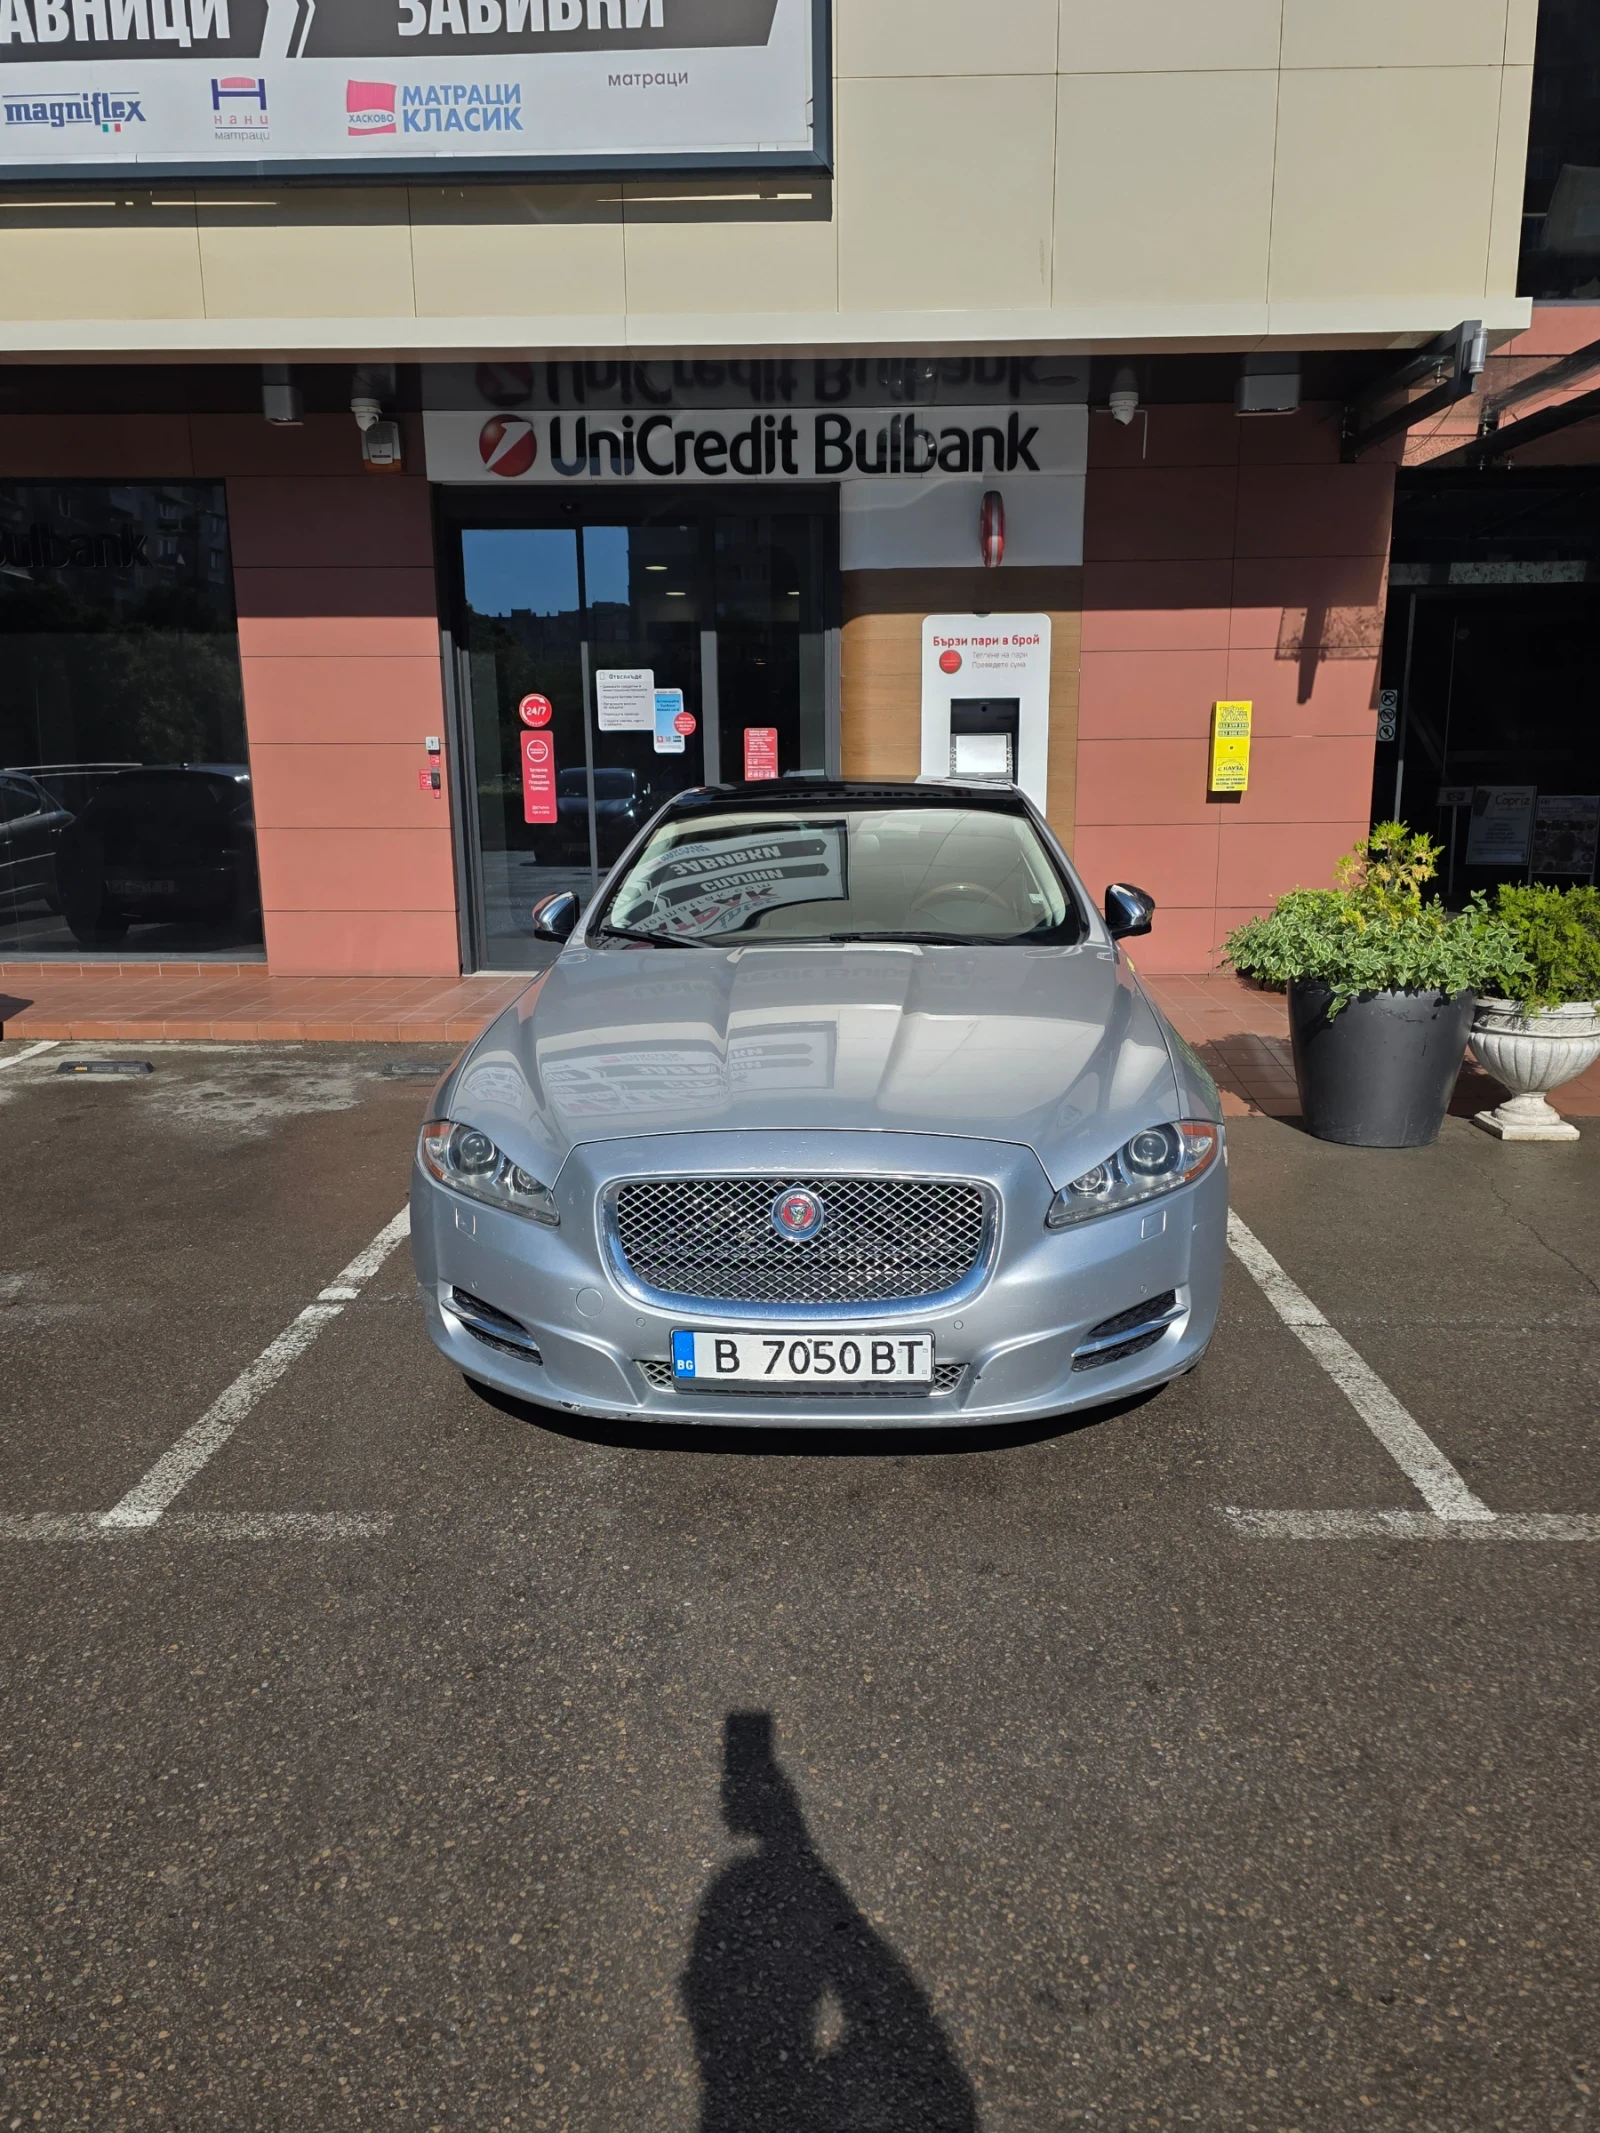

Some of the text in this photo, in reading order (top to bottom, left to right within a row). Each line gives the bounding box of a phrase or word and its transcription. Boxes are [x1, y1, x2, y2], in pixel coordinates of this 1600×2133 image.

[608, 72, 688, 89] матраци
[402, 84, 521, 106] МАТРАЦИ
[4, 92, 147, 127] magniflex
[349, 114, 394, 123] ХАСКОВО
[403, 107, 524, 132] КЛАСИК
[550, 411, 1040, 476] UniCredit Bulbank
[933, 634, 1040, 648] Бързи пари в брой
[526, 706, 547, 716] 24/7
[677, 1359, 694, 1371] BG
[714, 1338, 740, 1373] B
[762, 1340, 861, 1375] 7050
